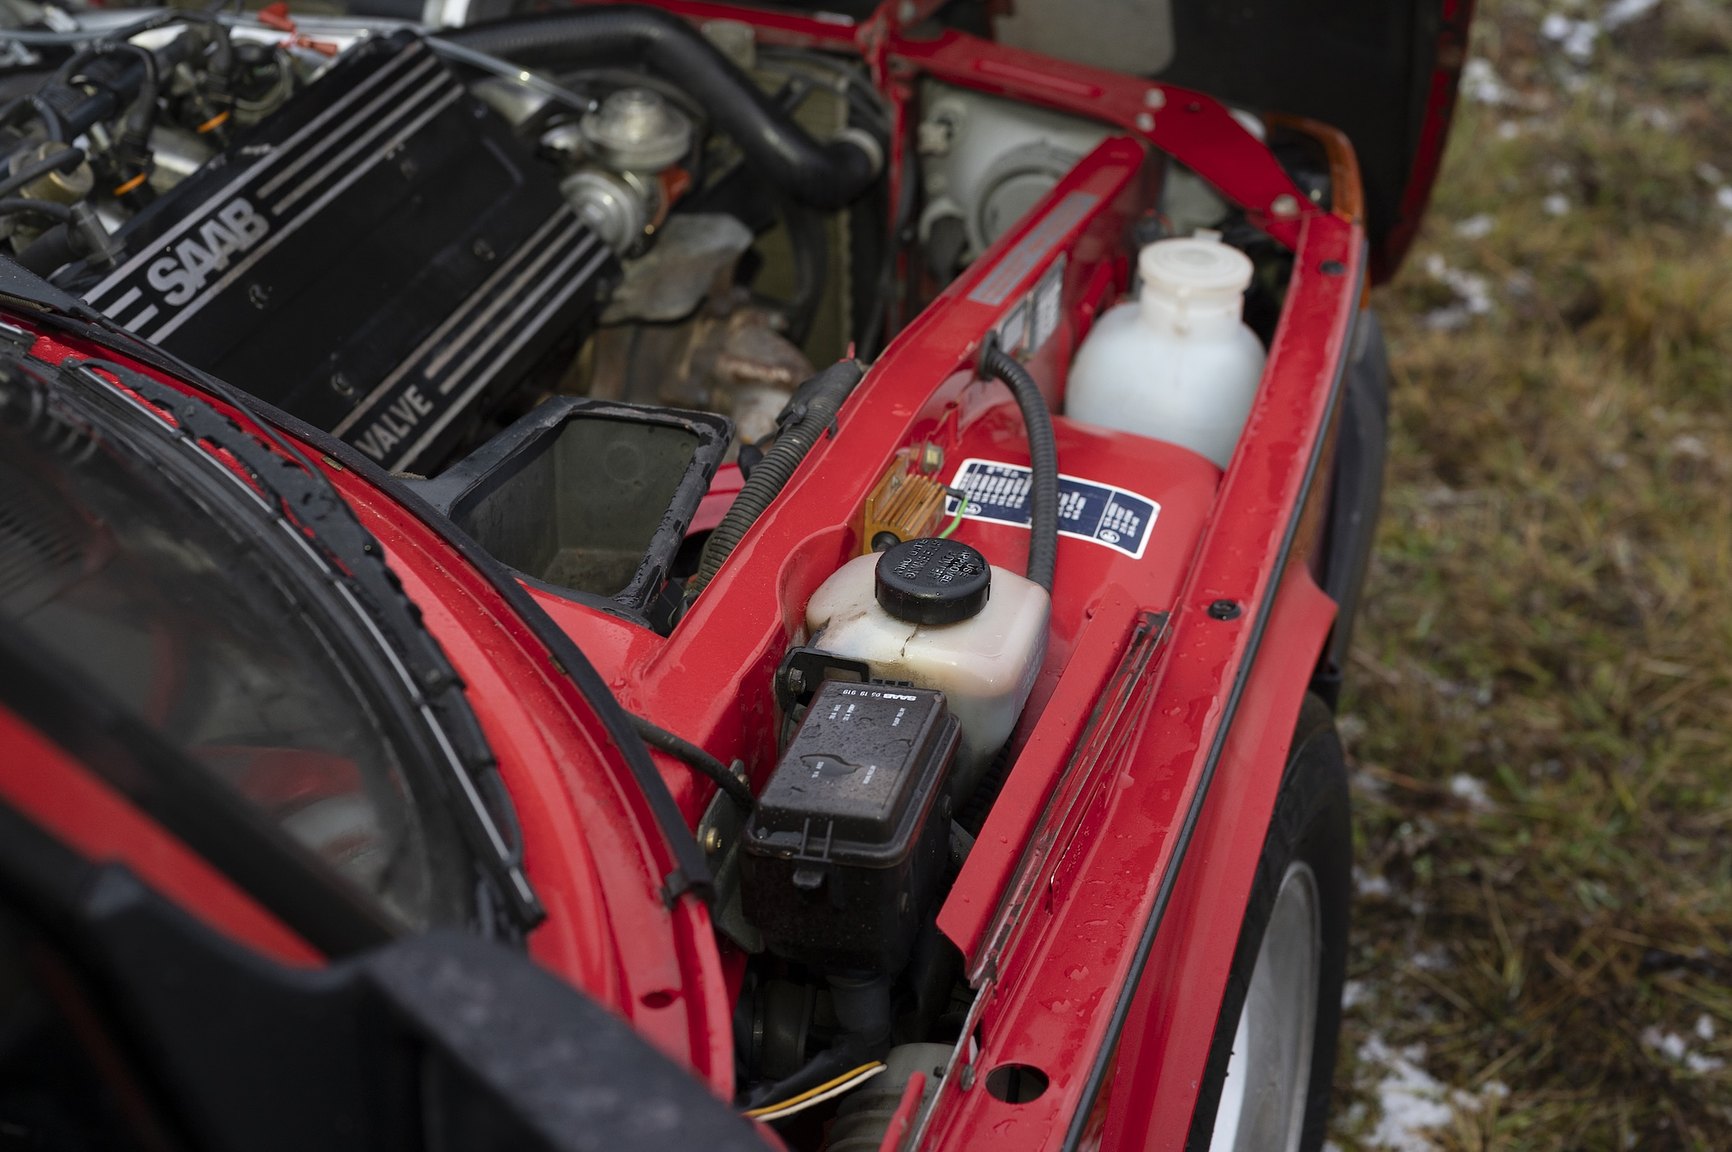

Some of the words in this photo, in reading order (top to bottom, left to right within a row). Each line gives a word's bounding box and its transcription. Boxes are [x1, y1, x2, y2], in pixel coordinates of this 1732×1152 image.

[147, 197, 269, 306] SAAB
[354, 384, 434, 460] VALVE
[959, 562, 975, 577] USE
[883, 693, 917, 701] SAAB
